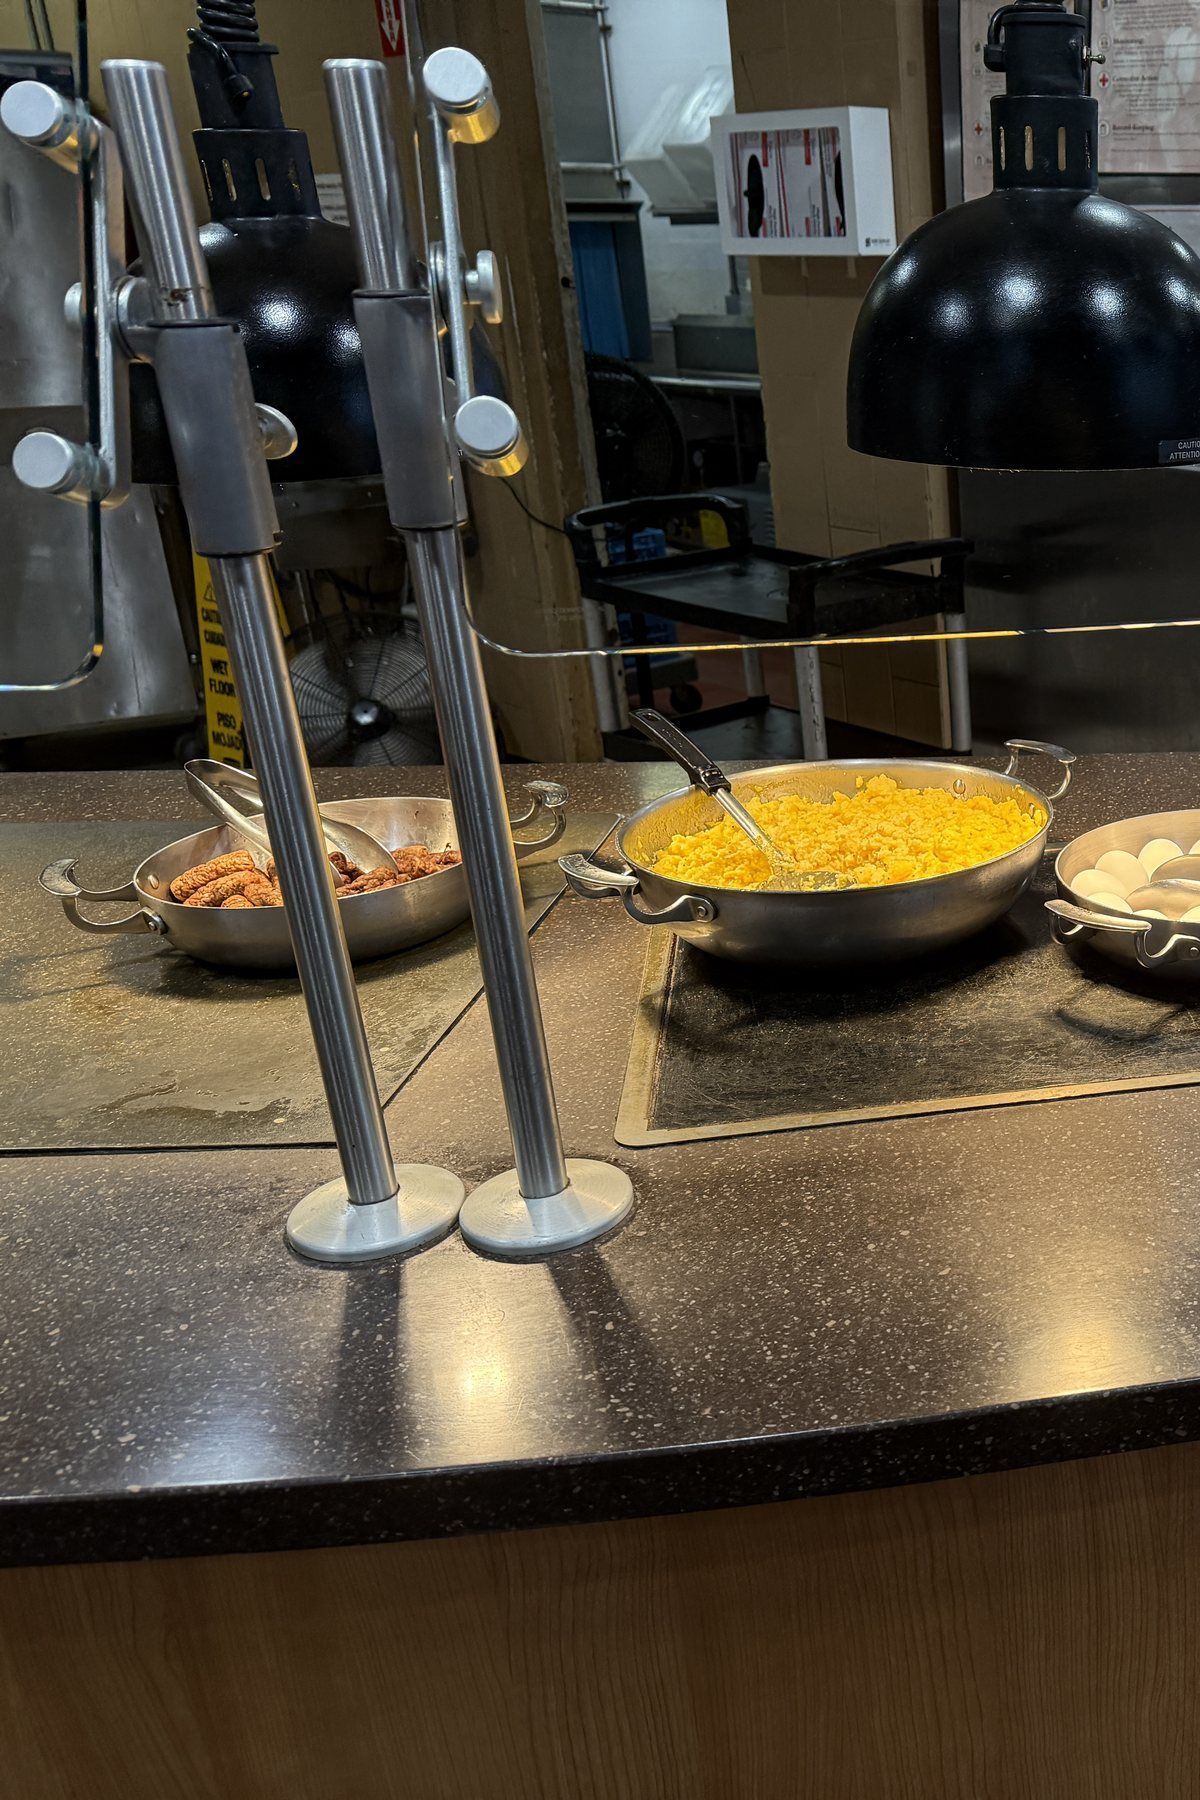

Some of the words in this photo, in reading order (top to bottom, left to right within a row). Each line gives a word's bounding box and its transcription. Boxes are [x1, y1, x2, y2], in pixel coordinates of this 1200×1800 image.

[210, 659, 228, 676] WET
[209, 678, 237, 697] FLOOR
[217, 711, 237, 730] PISO
[212, 730, 242, 751] MOJAD
